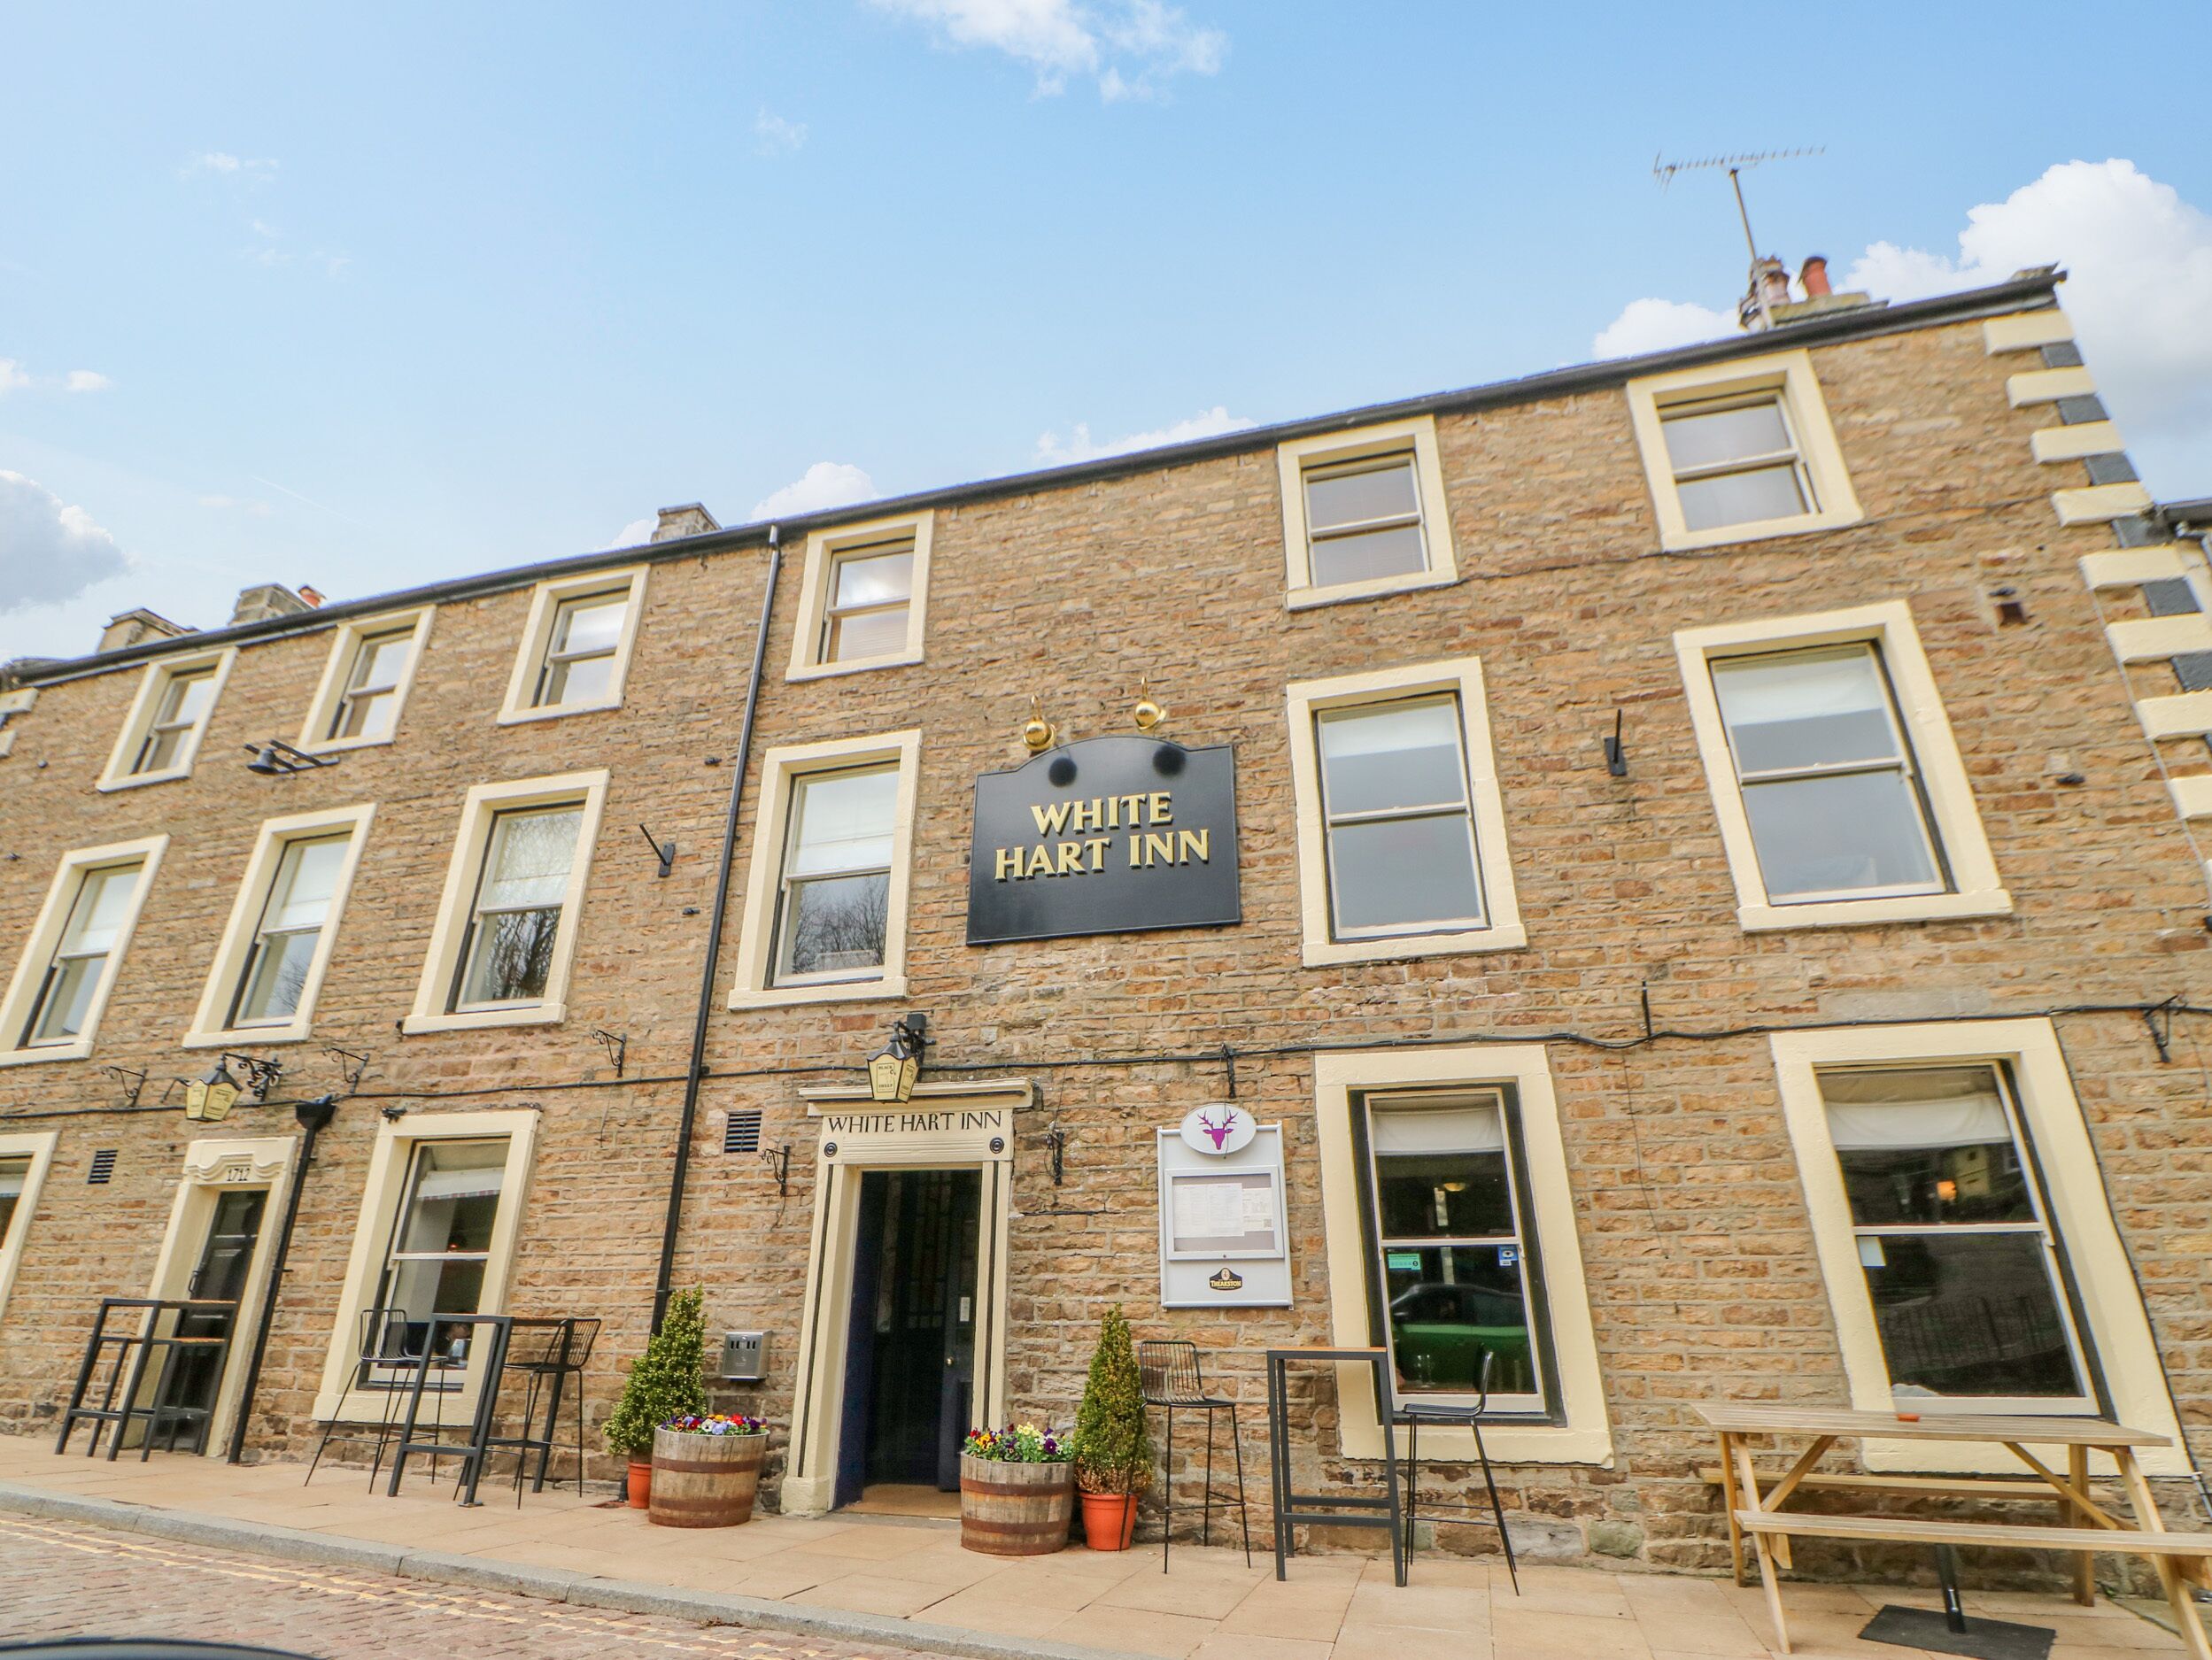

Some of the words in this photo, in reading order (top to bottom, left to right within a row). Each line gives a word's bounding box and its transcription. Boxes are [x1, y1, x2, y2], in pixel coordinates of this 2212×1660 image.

[1030, 791, 1173, 836] WHITE
[994, 838, 1110, 882] HART
[1128, 829, 1209, 869] INN
[828, 1115, 895, 1134] WHITE
[900, 1112, 955, 1132] HART
[961, 1110, 1002, 1131] INN
